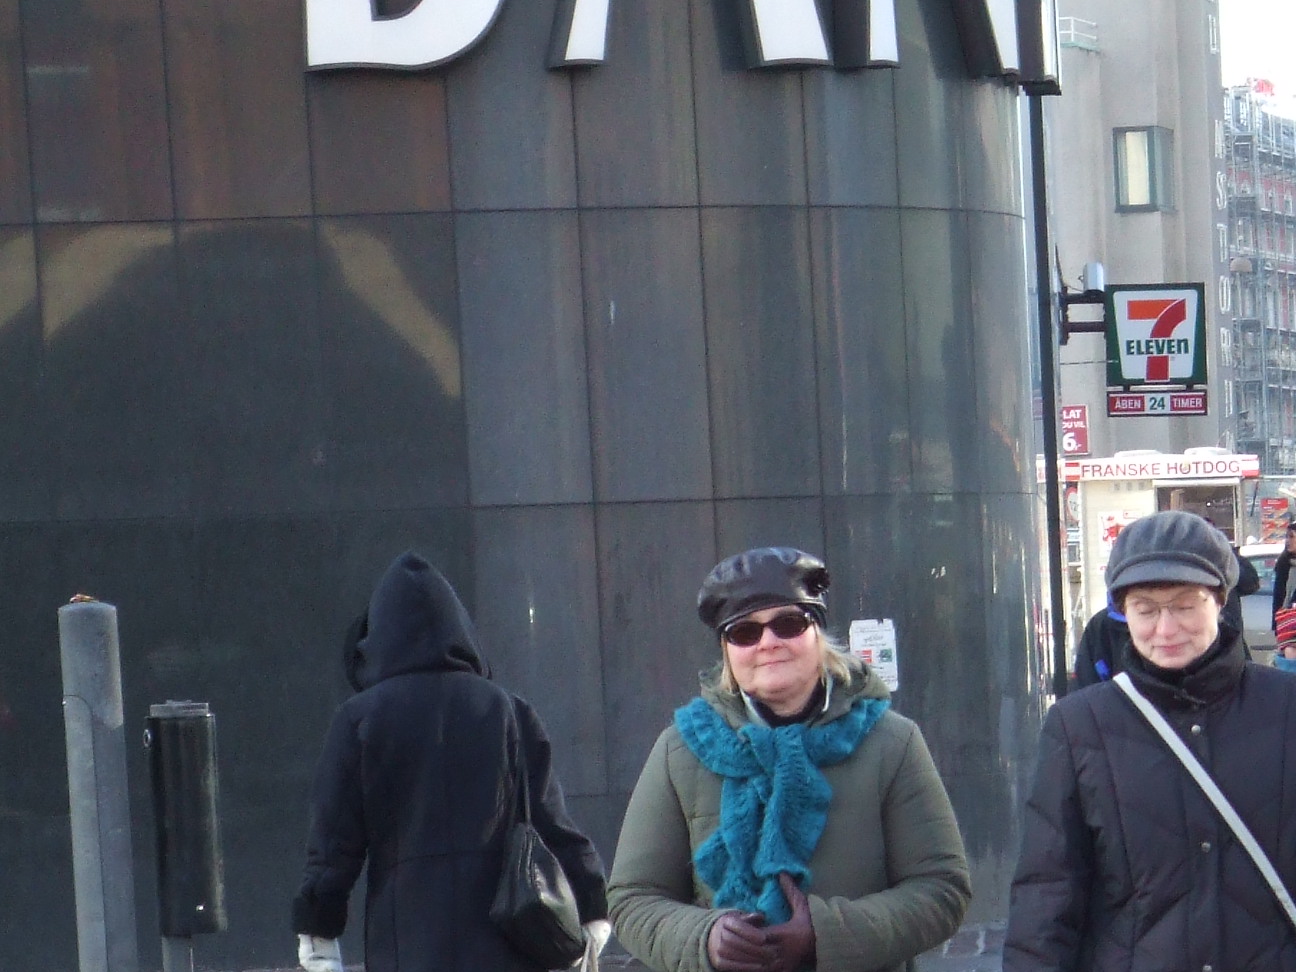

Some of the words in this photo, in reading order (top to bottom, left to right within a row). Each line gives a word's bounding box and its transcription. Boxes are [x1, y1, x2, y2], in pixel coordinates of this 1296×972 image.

[1127, 298, 1187, 382] 7
[1149, 397, 1166, 411] 24
[1173, 397, 1203, 409] TIMER
[1081, 462, 1161, 478] FRANSKE
